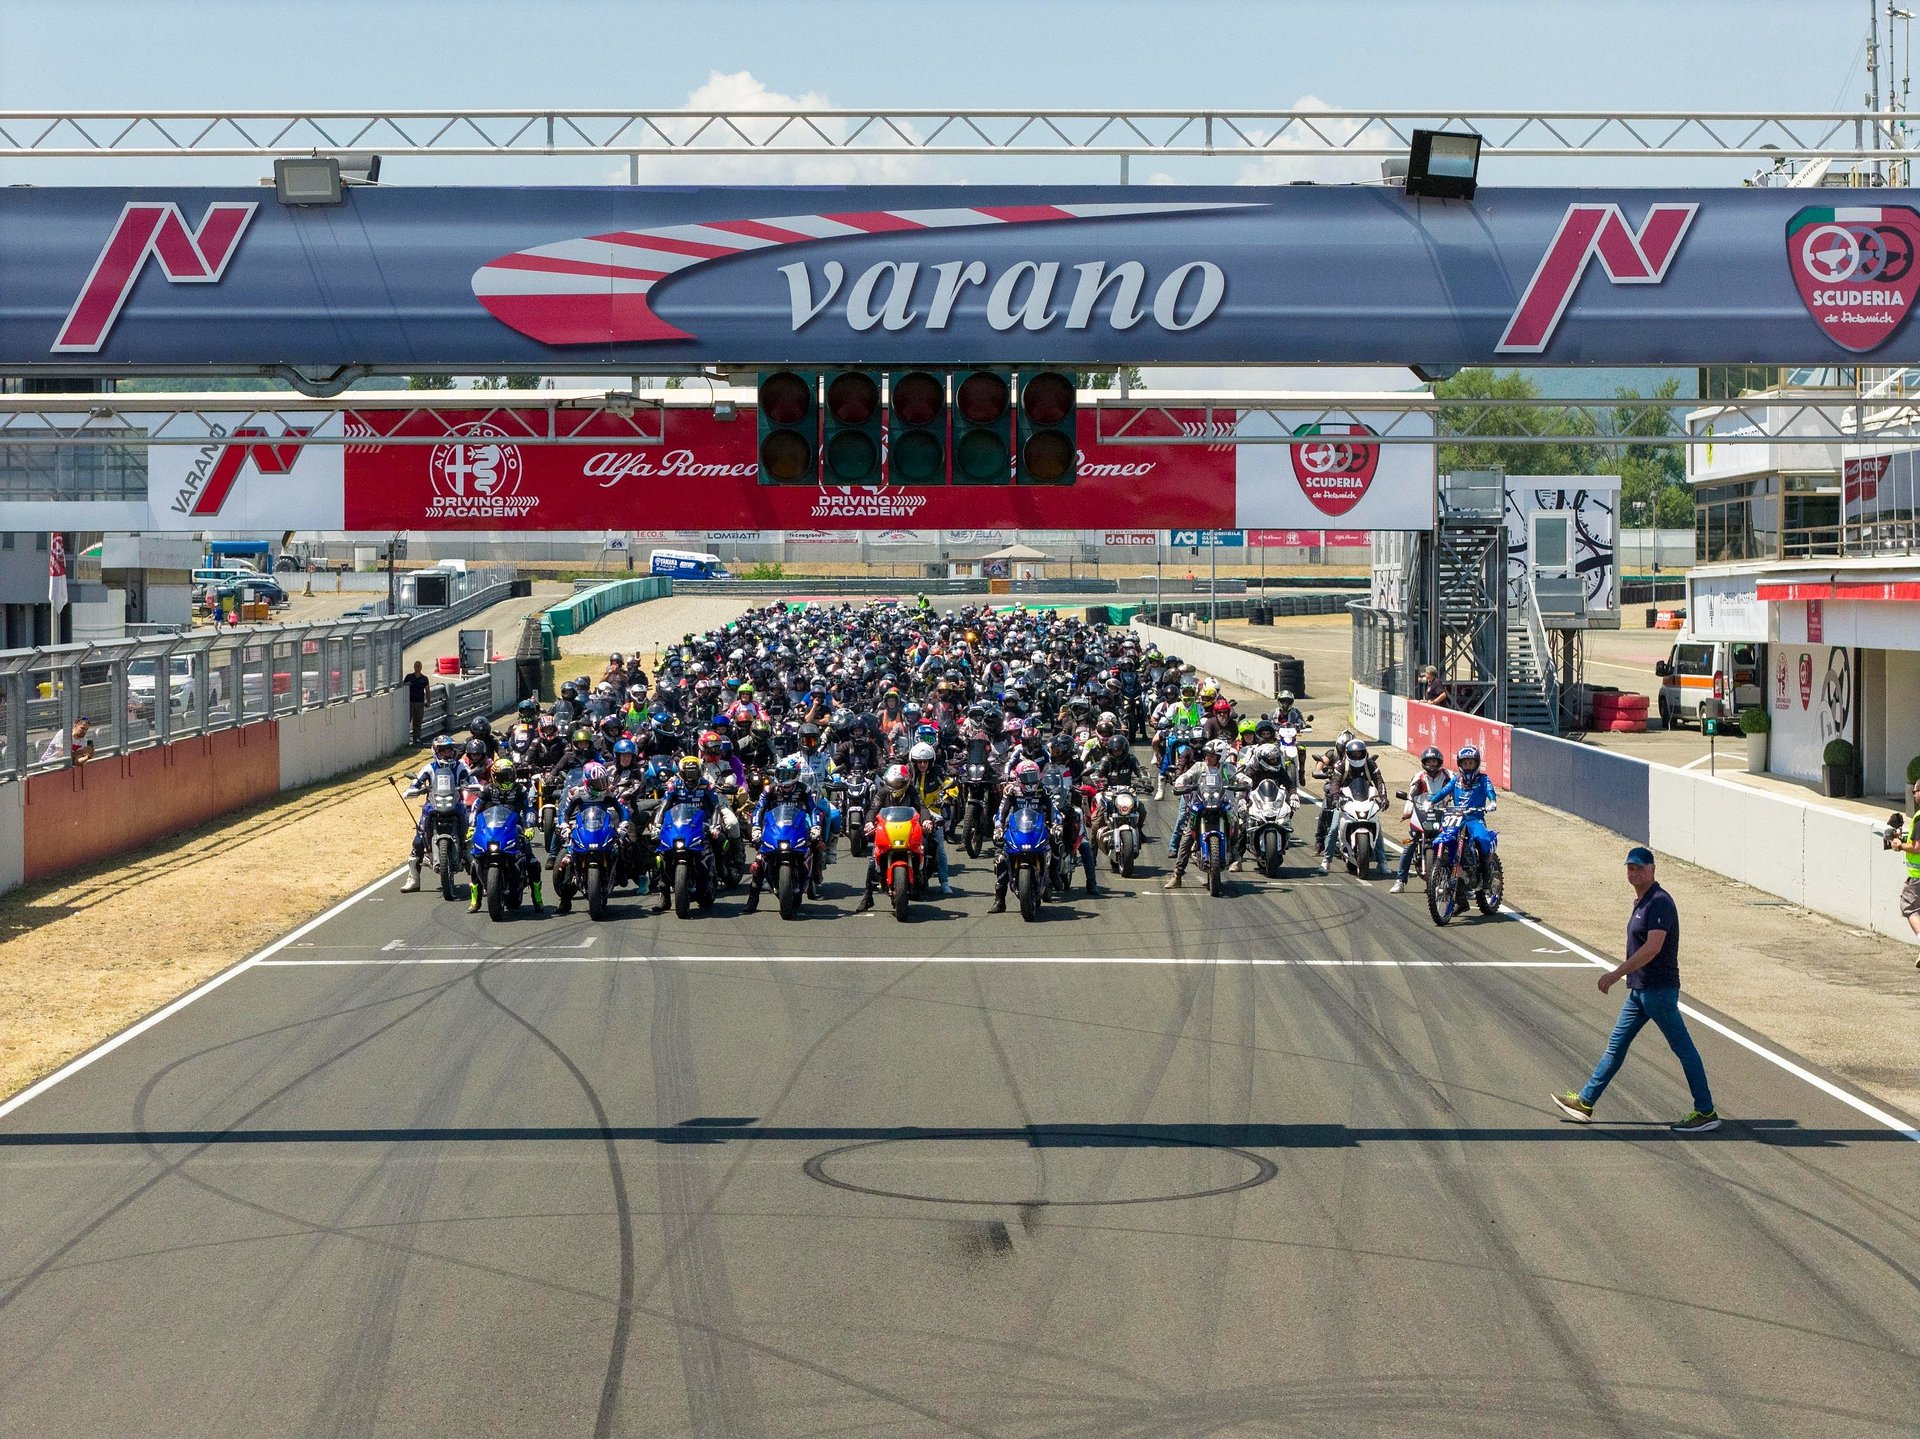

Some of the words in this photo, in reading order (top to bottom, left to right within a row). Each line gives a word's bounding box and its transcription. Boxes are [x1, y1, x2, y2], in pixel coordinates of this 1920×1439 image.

[777, 259, 1226, 331] varano
[1812, 290, 1905, 307] SCUDERIA
[1823, 311, 1839, 324] de
[582, 451, 658, 489] Alfa
[656, 448, 760, 478] Romeo
[1305, 477, 1364, 488] SCUDERIA
[432, 496, 504, 507] DRIVING
[818, 495, 891, 506] DRIVING
[443, 506, 531, 517] ACADEMY
[828, 506, 918, 517] ACADEMY
[706, 532, 761, 540] LOMBATTI
[1106, 534, 1155, 545] dallara
[1441, 815, 1464, 828] 371
